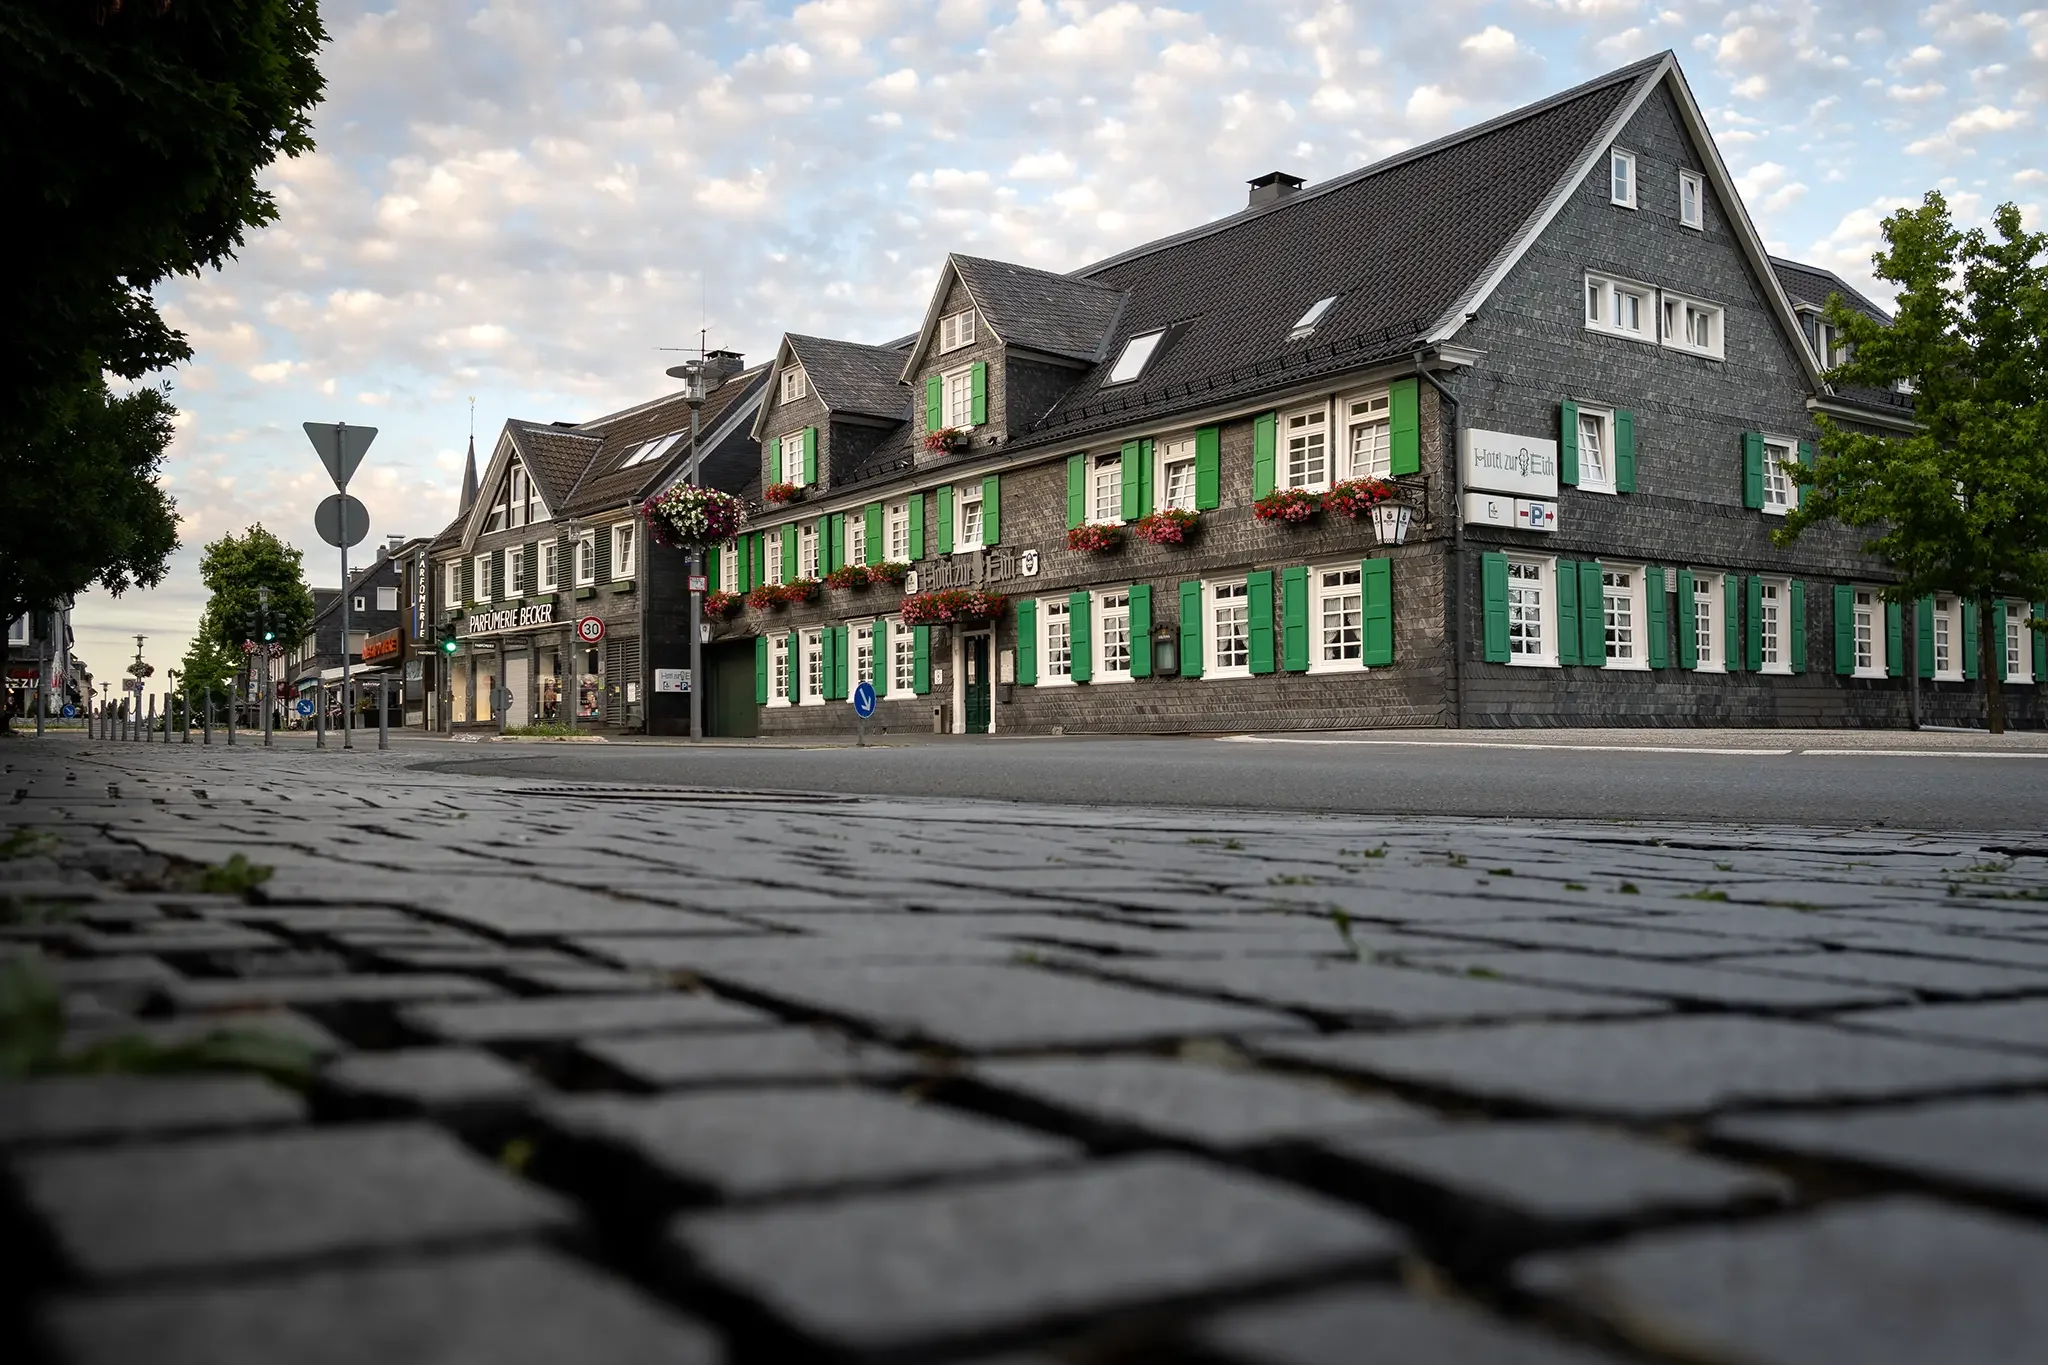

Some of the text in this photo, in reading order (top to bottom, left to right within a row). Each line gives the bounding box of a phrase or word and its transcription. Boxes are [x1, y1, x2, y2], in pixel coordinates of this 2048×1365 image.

[1474, 447, 1503, 470] Hotel
[1504, 454, 1518, 471] zur
[1531, 505, 1543, 524] P
[469, 603, 552, 633] PARFÜMERIE BECKER
[584, 623, 600, 636] 30
